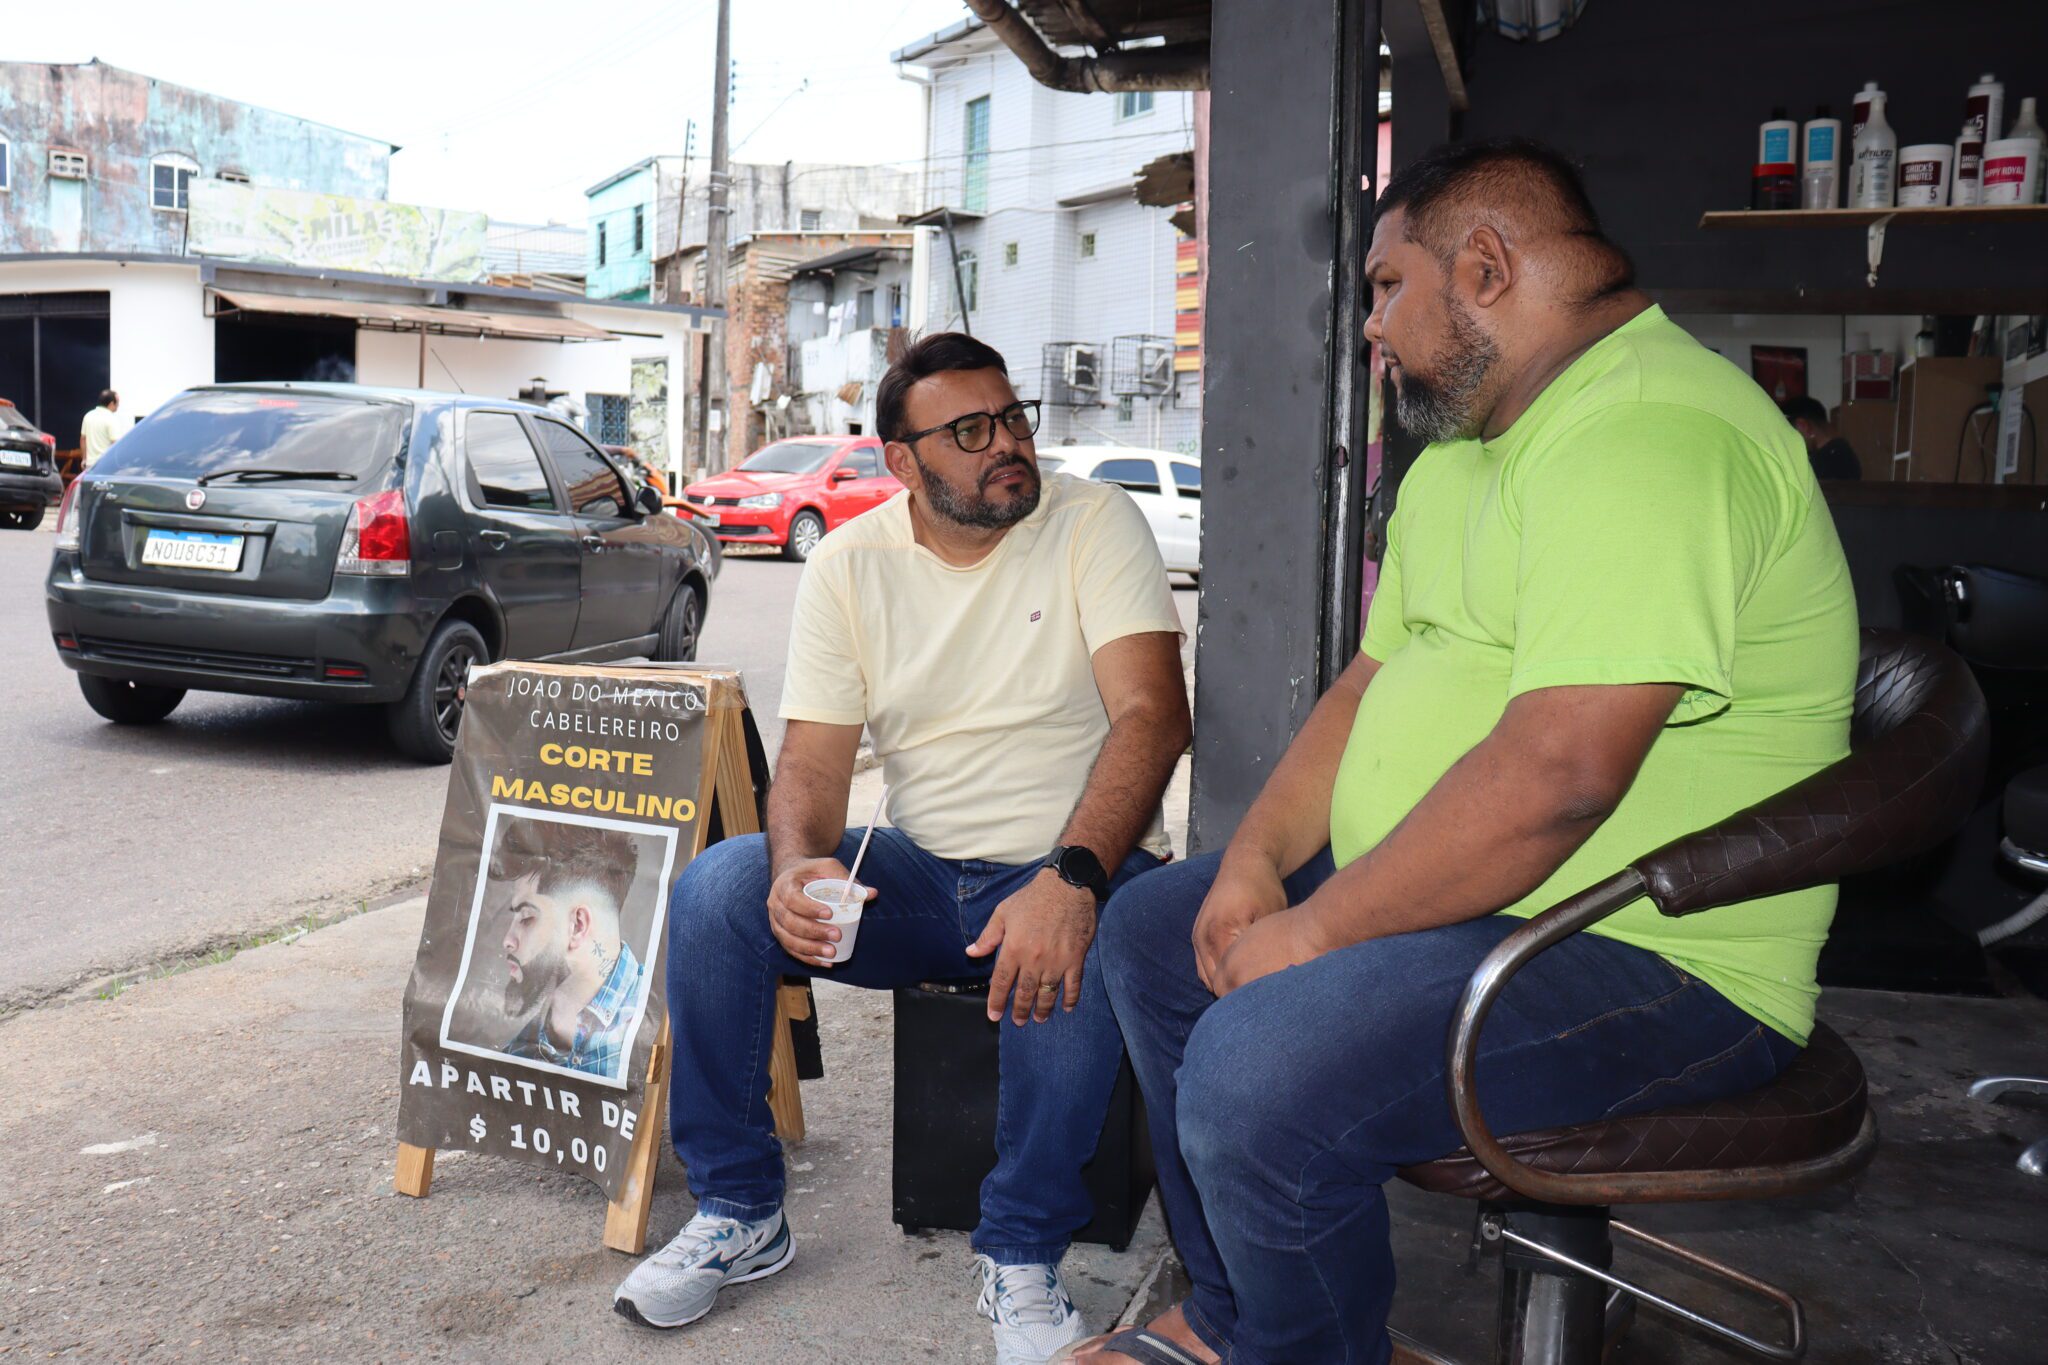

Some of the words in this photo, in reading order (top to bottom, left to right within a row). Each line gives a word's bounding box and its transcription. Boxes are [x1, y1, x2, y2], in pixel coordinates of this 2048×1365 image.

[152, 541, 227, 564] NOU8C31
[507, 677, 562, 698] JOAO
[571, 683, 602, 702] DO
[613, 686, 699, 711] MEXICO
[530, 710, 680, 741] CABELEREIRO
[539, 743, 653, 776] CORTE
[491, 775, 696, 822] MASCULINO
[601, 1100, 638, 1141] DE
[469, 1113, 487, 1143] $
[510, 1123, 607, 1173] 10,00
